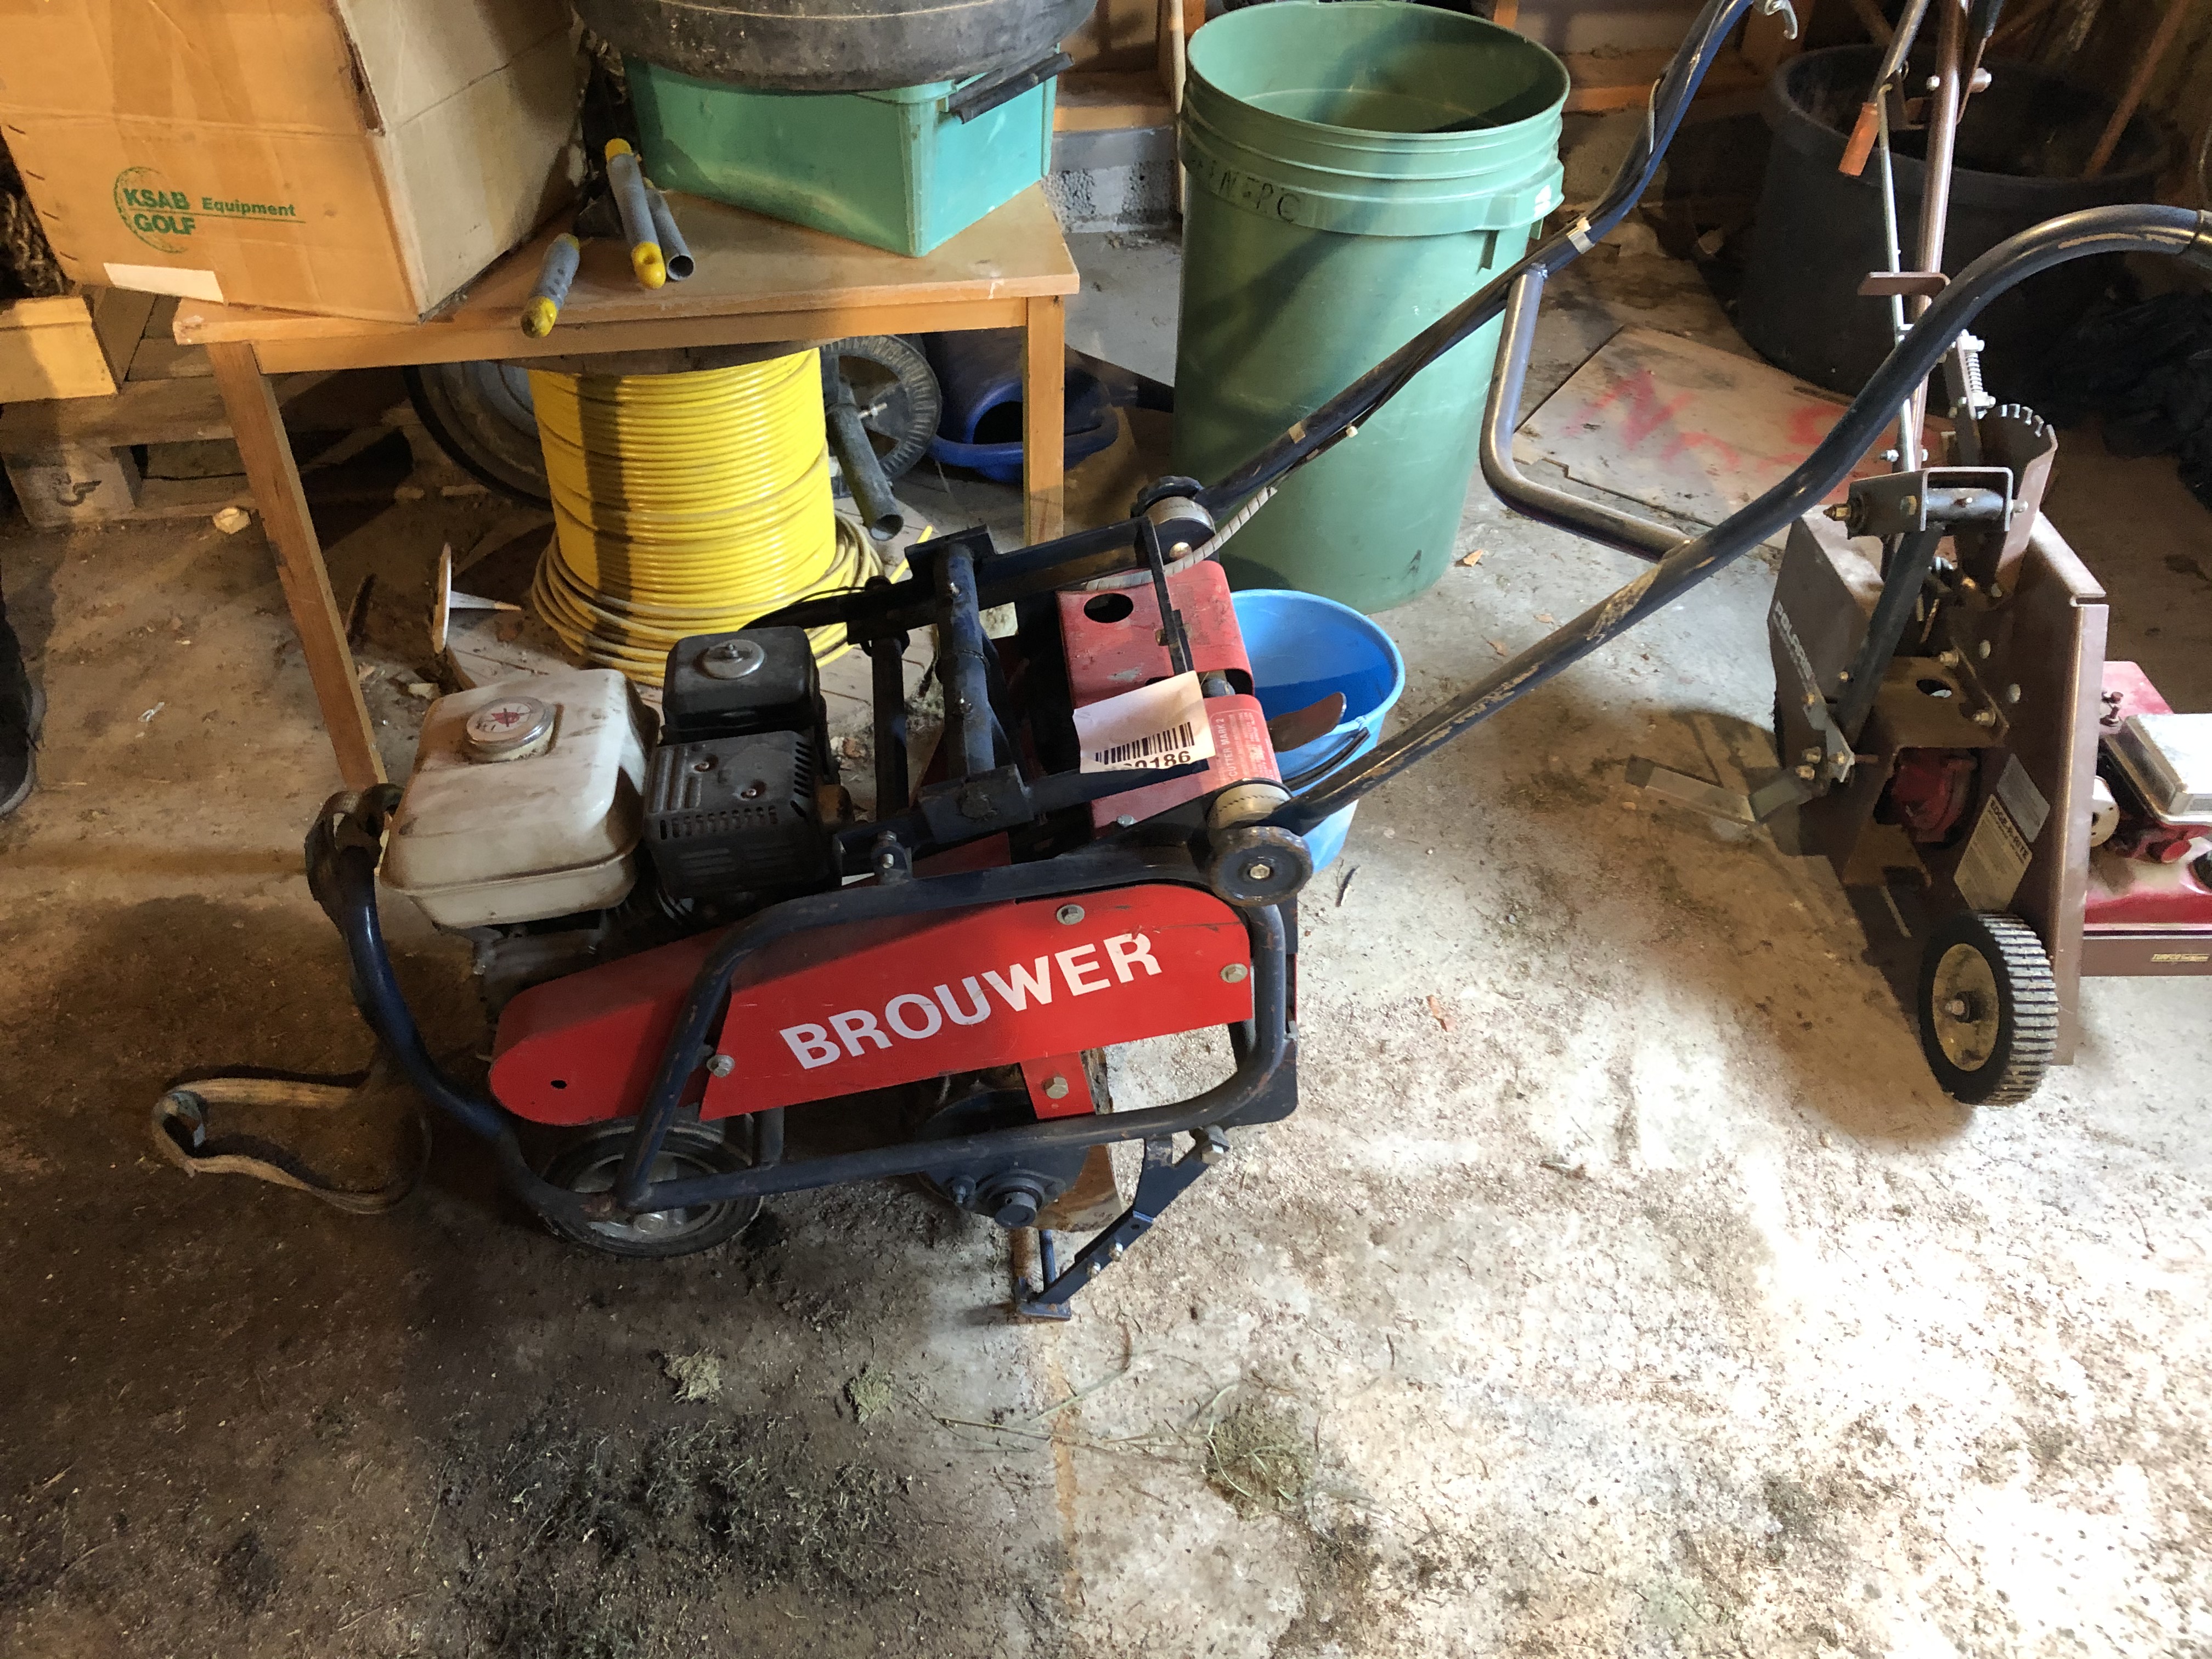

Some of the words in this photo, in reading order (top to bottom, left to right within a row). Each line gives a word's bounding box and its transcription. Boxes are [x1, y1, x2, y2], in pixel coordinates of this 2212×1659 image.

[122, 188, 190, 210] KSAB
[201, 196, 296, 217] Equipment
[133, 213, 196, 235] GOLF
[1217, 725, 1230, 746] MARK
[1222, 747, 1238, 777] CUTTER
[779, 932, 1163, 1070] BROUWER
